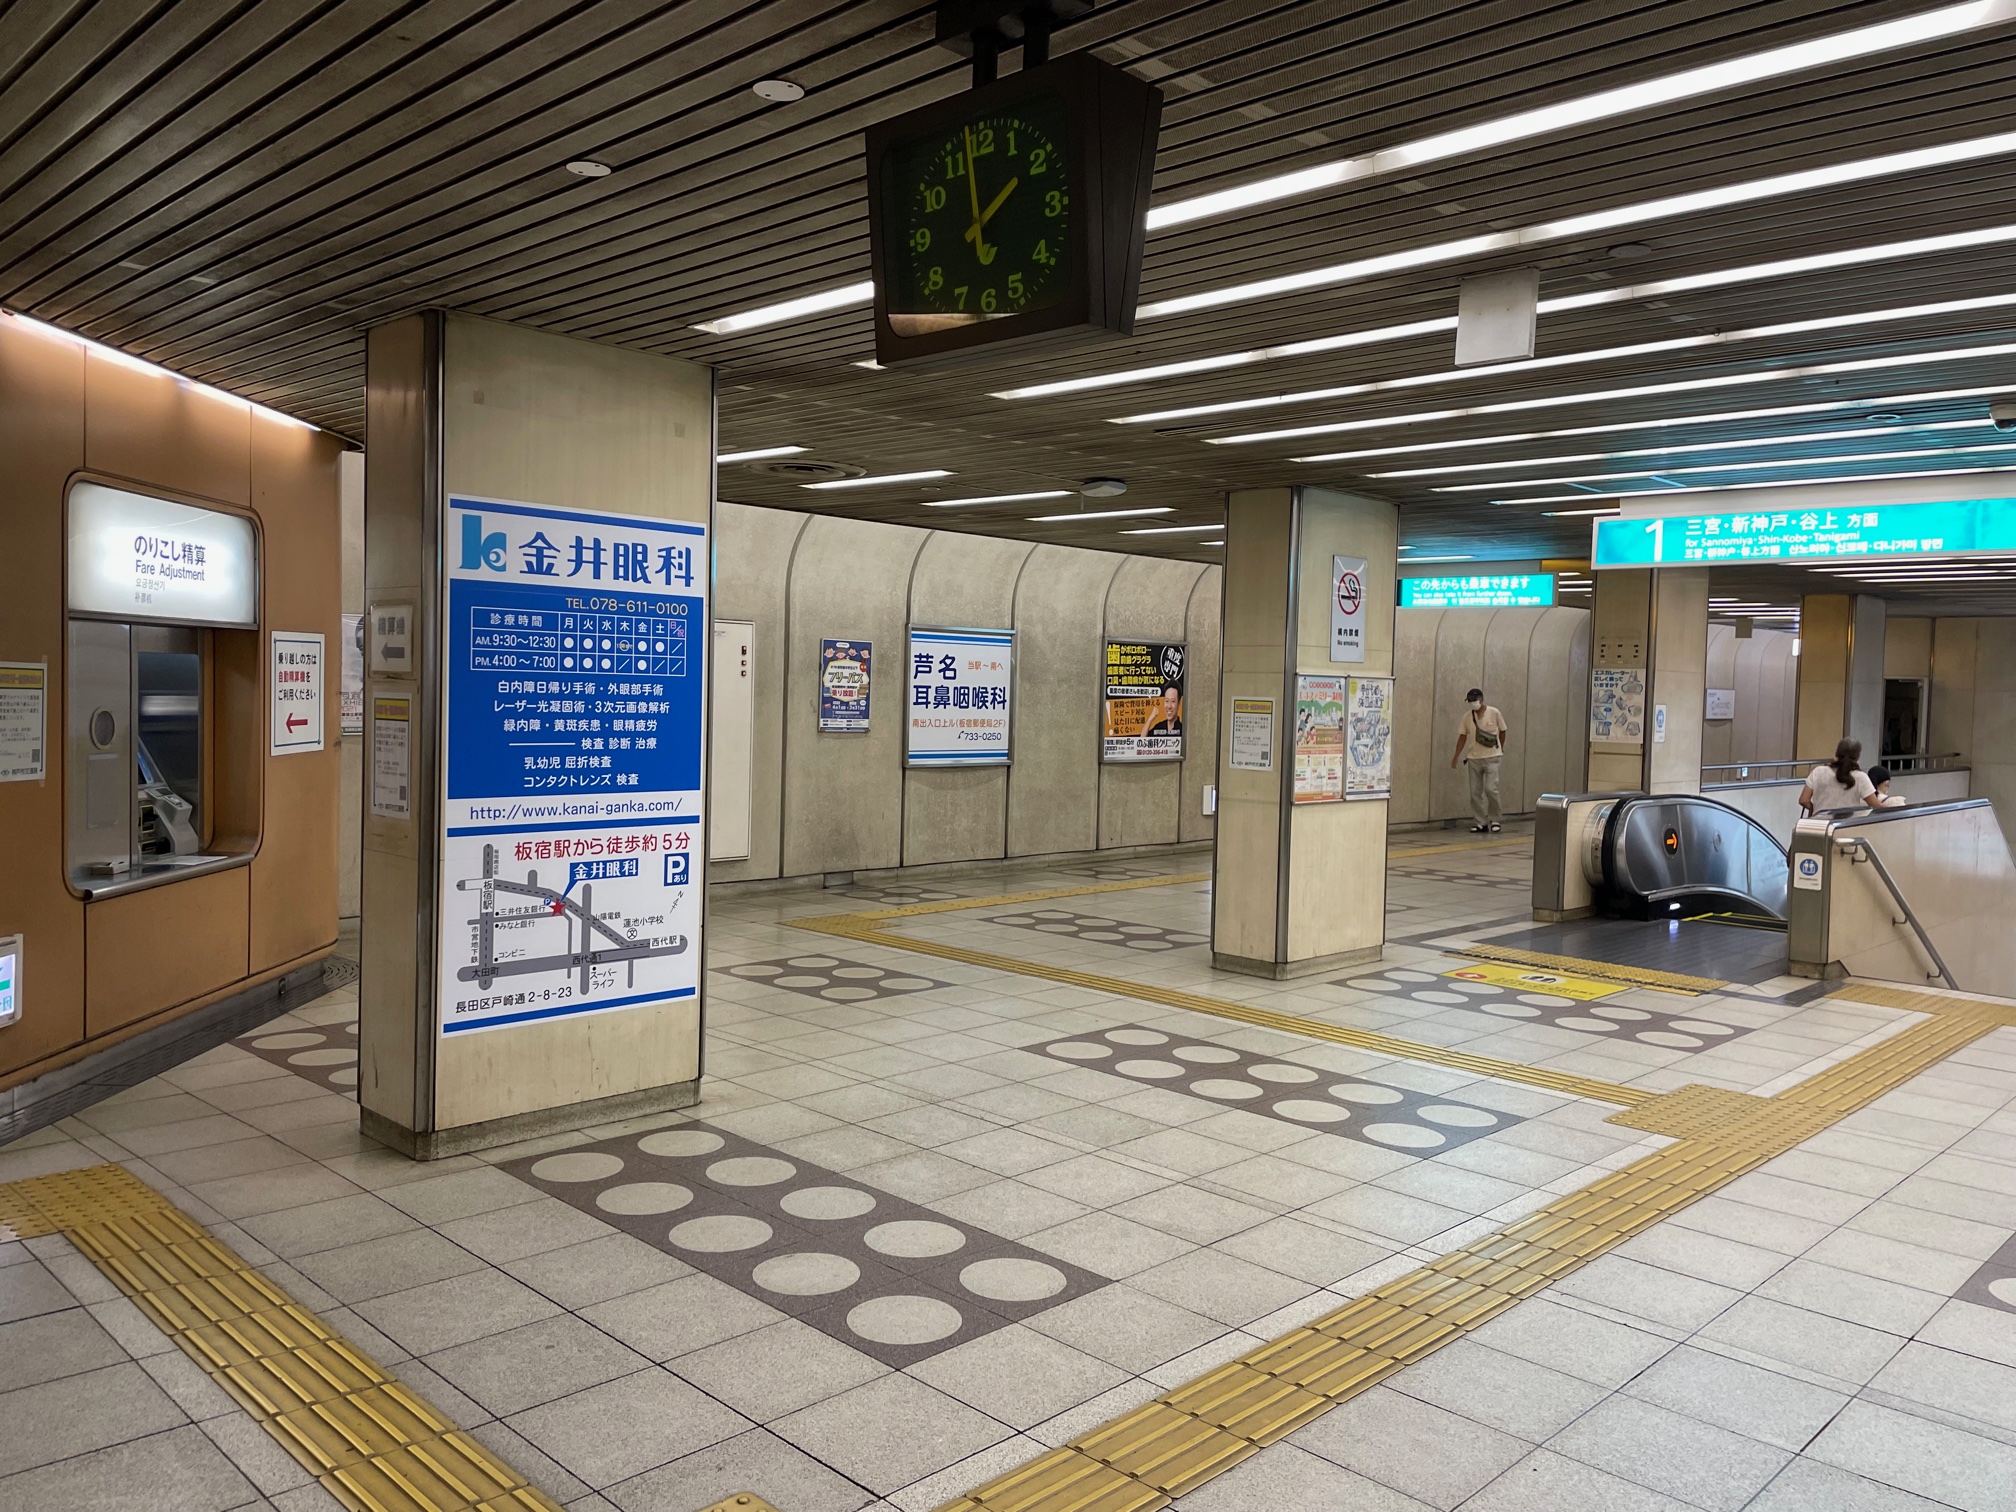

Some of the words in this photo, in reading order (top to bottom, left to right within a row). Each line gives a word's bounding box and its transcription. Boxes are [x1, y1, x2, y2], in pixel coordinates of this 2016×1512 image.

[969, 129, 994, 157] 12
[1006, 131, 1017, 156] 1
[945, 152, 965, 179] 11
[1029, 149, 1046, 175] 2
[923, 186, 946, 213] 10
[1044, 191, 1061, 217] 3
[916, 228, 931, 252] 9
[1032, 239, 1049, 264] 4
[929, 267, 943, 290] 8
[1007, 272, 1024, 298] 5
[954, 285, 969, 310] 7
[980, 288, 997, 313] 6
[1685, 512, 1839, 536] 三宮・新神戸・谷上
[1847, 512, 1879, 528] 方面
[1645, 519, 1663, 562] 1
[1685, 538, 1698, 547] for
[134, 535, 206, 566] のりこし精算
[518, 532, 694, 588] 金井眼科
[135, 559, 155, 575] Fare
[159, 563, 205, 581] Adjustment
[490, 613, 542, 627] 診療時間
[564, 618, 574, 628] 月
[583, 619, 593, 630] 火
[602, 620, 612, 631] 水
[620, 621, 630, 632] 木
[638, 622, 648, 633] 金
[655, 623, 665, 633] 土
[278, 653, 317, 665] 乗り越しの方は
[1107, 644, 1120, 665] 歯
[913, 653, 957, 680] 芦名
[828, 672, 864, 684] フリーパス
[278, 689, 316, 701] ご利用ください
[498, 681, 664, 696] 白内障日帰り手術・外眼部手術
[912, 685, 1007, 710] 耳鼻咽喉科
[494, 700, 670, 714] レーザー光凝固術・3次元画像解析
[503, 719, 658, 732] 緑内障・黄斑疾患・眼精疲労
[964, 732, 1002, 740] 733-0250
[581, 738, 604, 750] 検査
[609, 738, 631, 750] 診断
[635, 738, 657, 750] 治療
[524, 757, 561, 770] 乳幼児
[565, 756, 612, 769] 屈折検査
[524, 773, 612, 788] コンタクトレンズ
[616, 773, 639, 786] 検査
[470, 798, 683, 820] http://www.kanai-ganka.com/
[514, 832, 691, 861] 板宿駅から徒歩約5分
[573, 860, 637, 880] 金井眼科
[667, 855, 686, 884] P
[674, 874, 687, 884] あり
[483, 881, 493, 911] 板宿駅
[500, 905, 546, 916] 三井住友銀行
[499, 920, 535, 930] みなと銀行
[623, 915, 664, 928] 蓮池小学校
[471, 926, 479, 963] 市営地下鉄
[651, 935, 677, 947] 西代駅
[498, 949, 526, 958] コンビニ
[471, 966, 500, 978] 大田町
[590, 968, 617, 980] スーパー
[592, 979, 614, 989] ライフ
